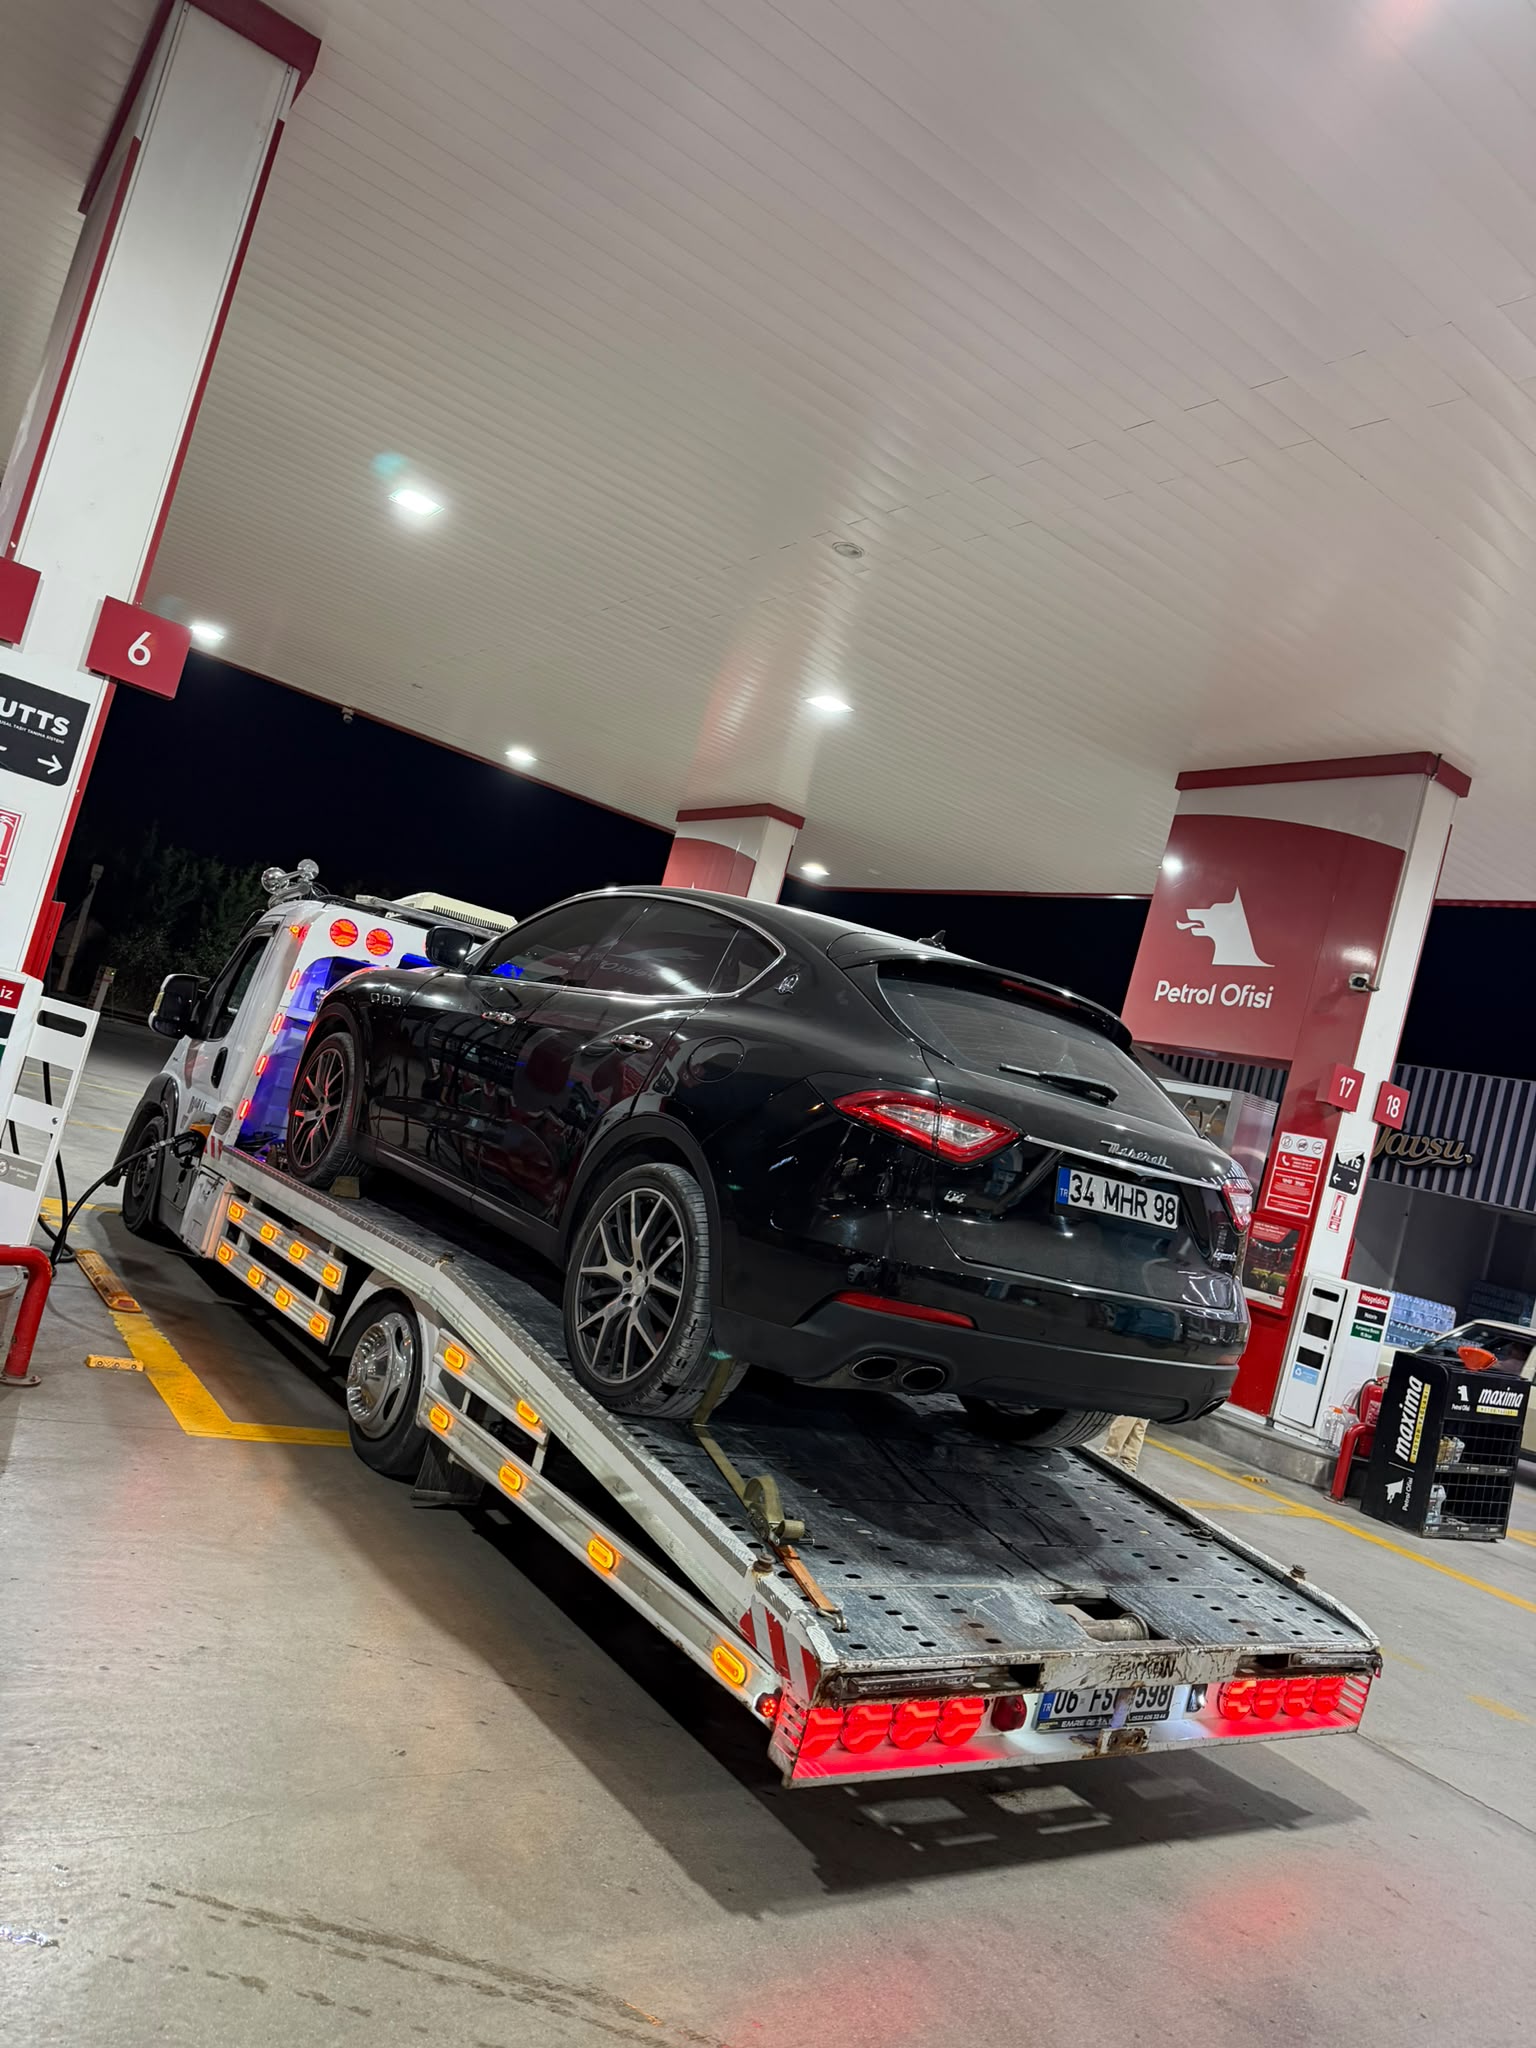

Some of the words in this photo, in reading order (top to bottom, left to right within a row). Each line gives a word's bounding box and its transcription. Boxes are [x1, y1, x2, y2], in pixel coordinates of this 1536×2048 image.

[128, 631, 152, 666] 6
[0, 696, 70, 736] UTTS
[1154, 980, 1217, 1004] Petrol
[1220, 983, 1274, 1008] Ofisi
[1339, 1076, 1356, 1098] 17
[1386, 1094, 1401, 1118] 18
[1100, 1140, 1174, 1170] Maserati
[1060, 1187, 1069, 1198] TR
[1070, 1173, 1095, 1207] 34
[1103, 1180, 1148, 1219] MHR
[1154, 1193, 1176, 1225] 98
[1478, 1386, 1524, 1408] maxima
[1395, 1375, 1423, 1461] maxima
[1413, 1429, 1421, 1455] MOTOR
[1405, 1477, 1413, 1492] Ofisi
[1402, 1492, 1410, 1511] Petrol
[1043, 1702, 1052, 1712] TR
[1054, 1690, 1079, 1714] 06
[1135, 1685, 1171, 1709] 598
